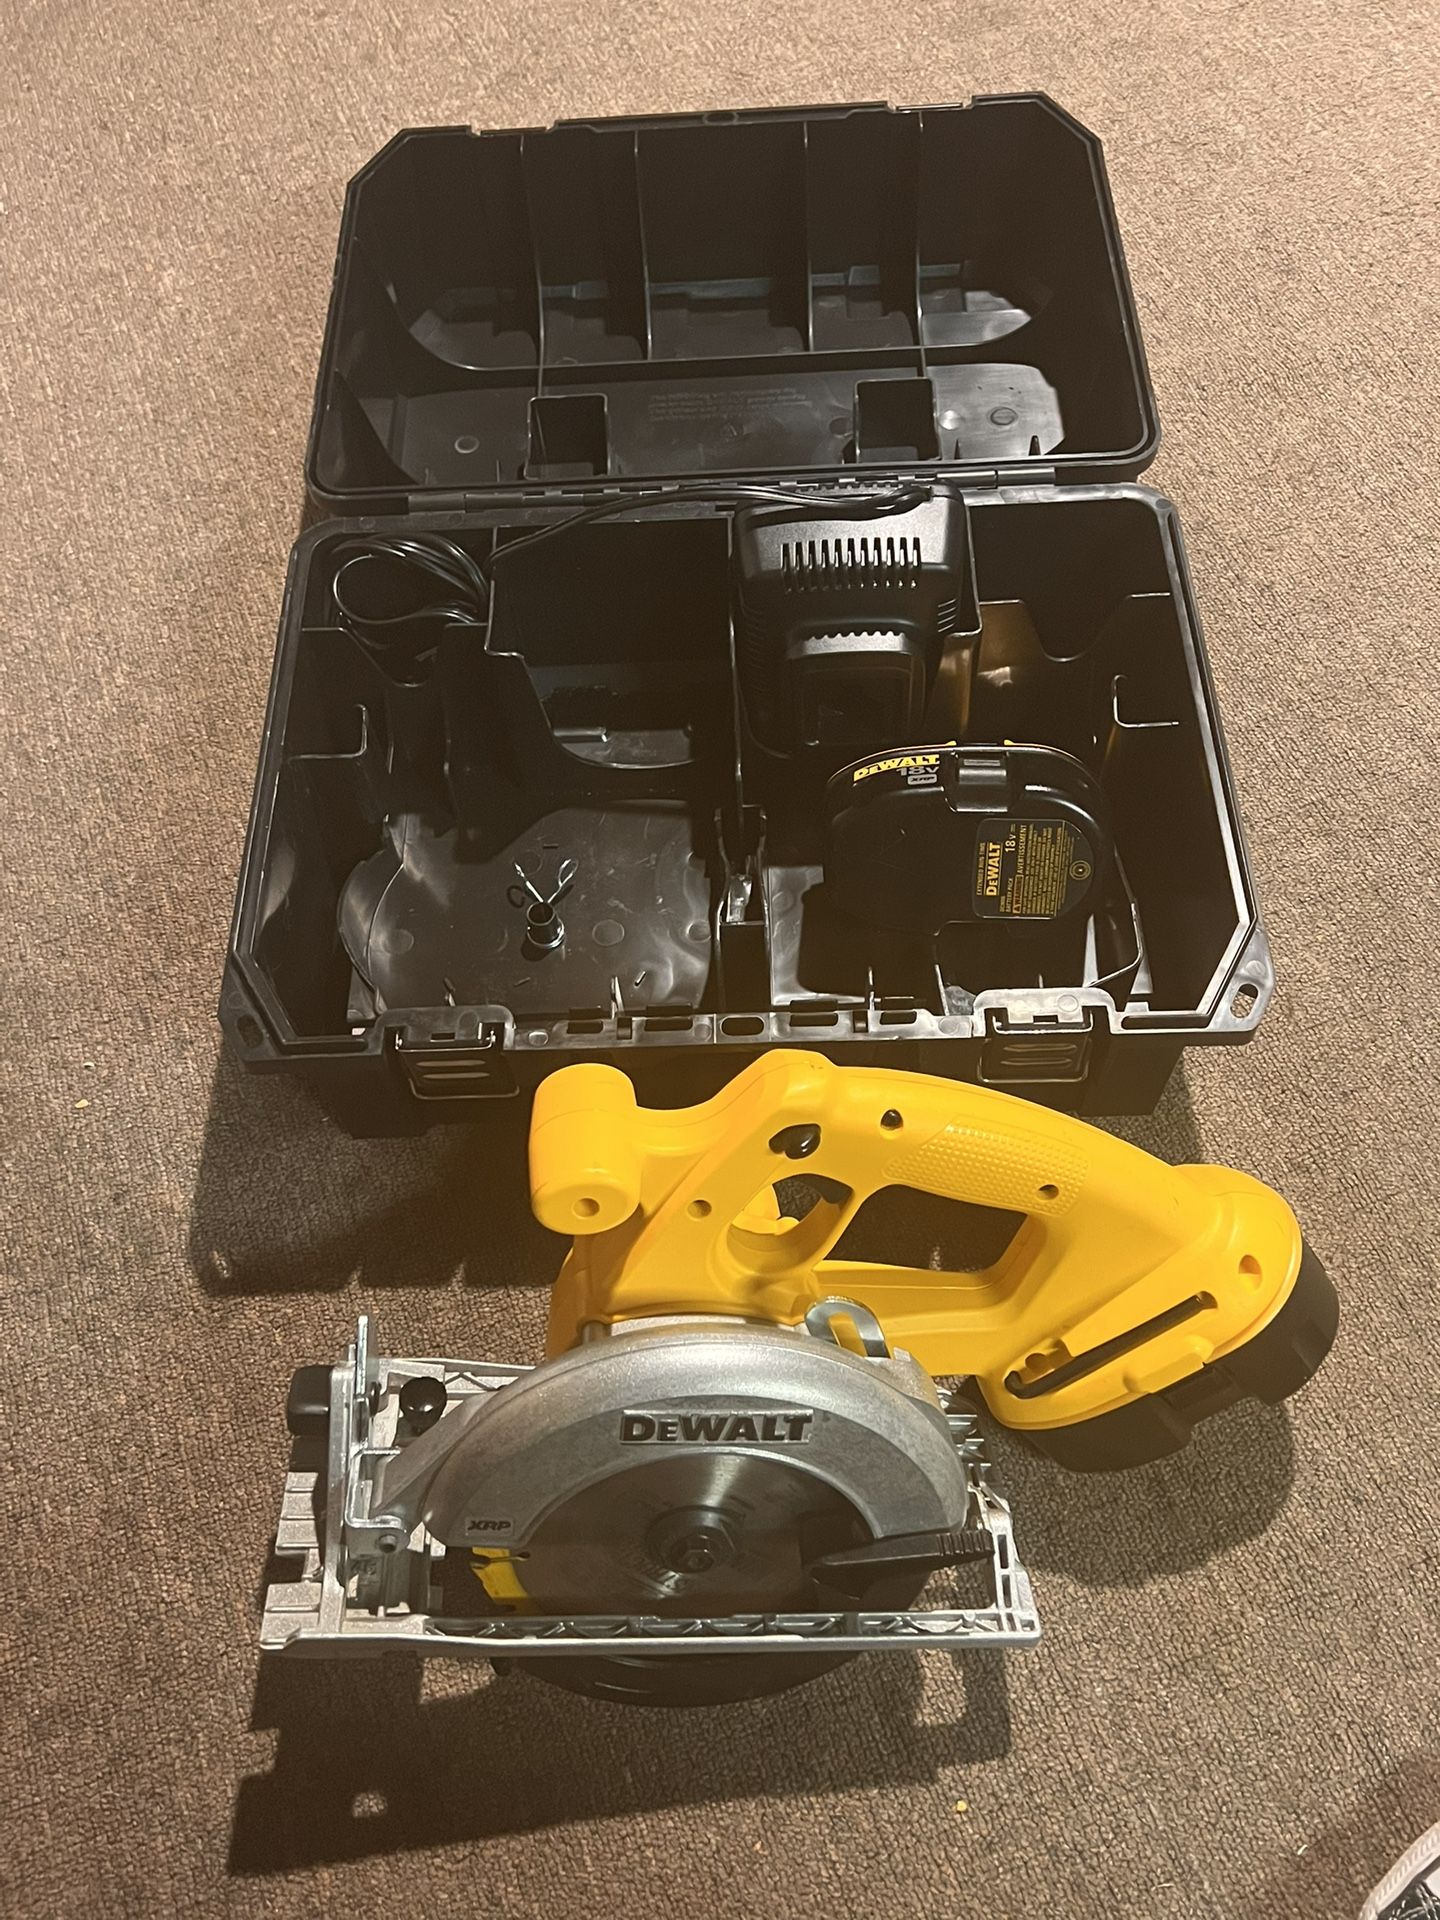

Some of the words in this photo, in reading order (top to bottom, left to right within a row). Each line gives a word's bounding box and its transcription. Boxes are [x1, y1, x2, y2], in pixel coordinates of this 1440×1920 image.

[853, 754, 940, 782] DEWALT
[1017, 824, 1027, 874] AVERTISSEMENT
[986, 842, 1001, 896] DEWALT
[621, 1413, 814, 1442] DEWALT
[467, 1519, 511, 1531] XRP
